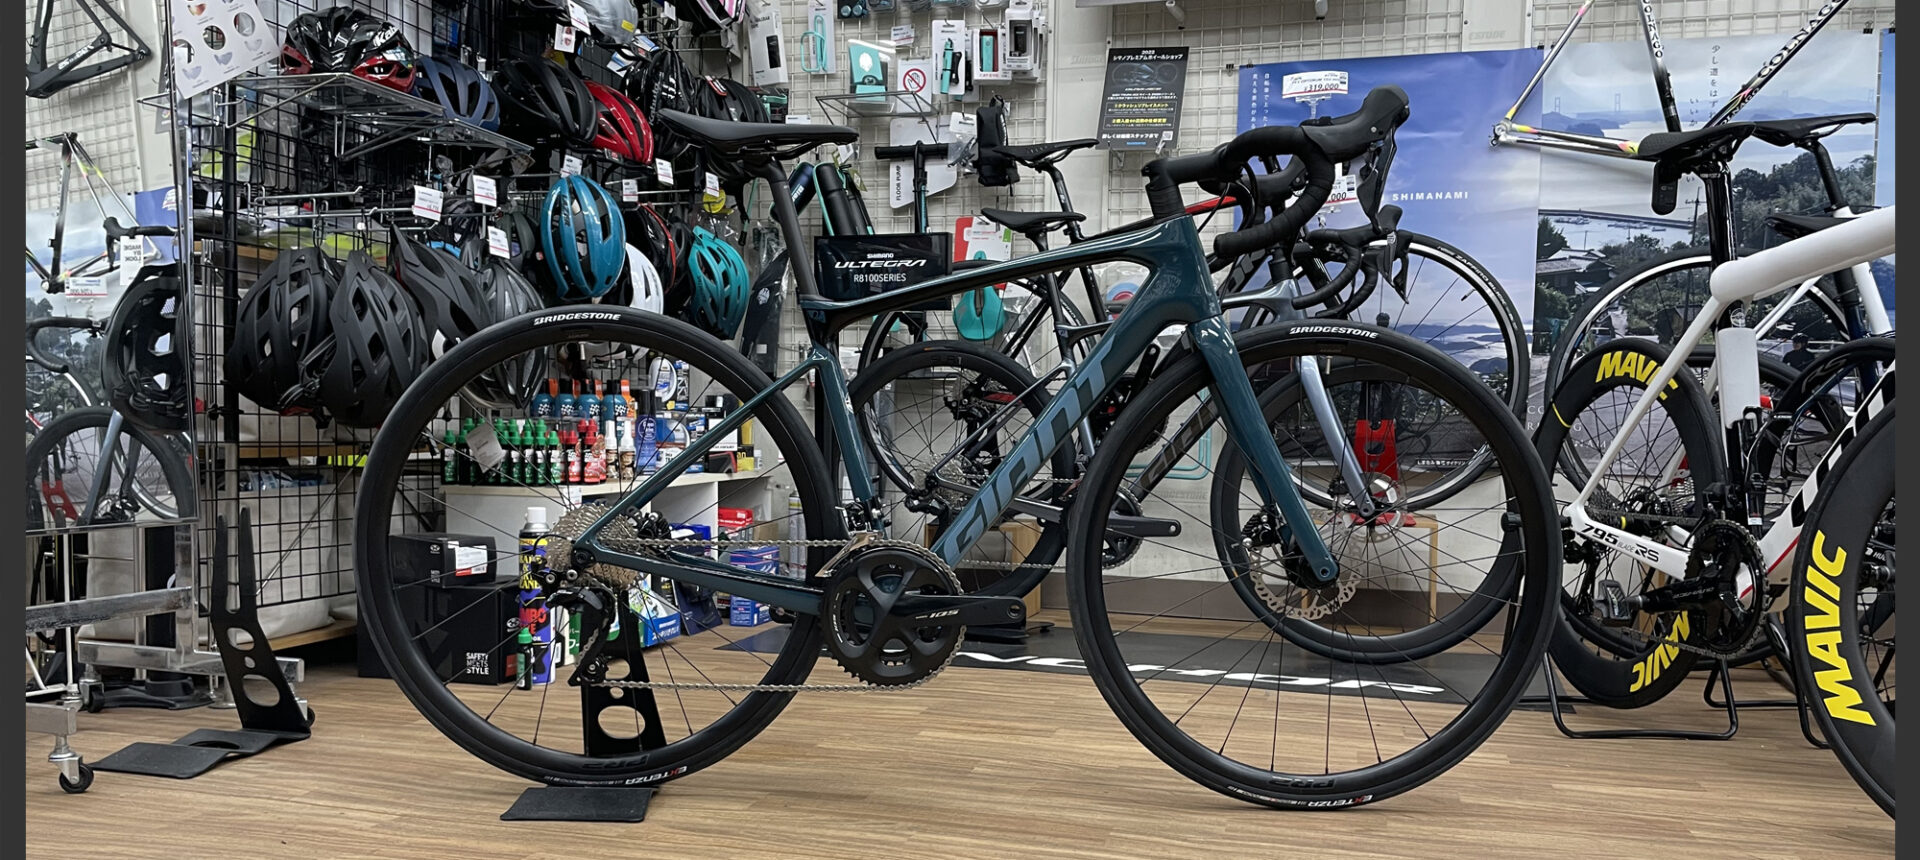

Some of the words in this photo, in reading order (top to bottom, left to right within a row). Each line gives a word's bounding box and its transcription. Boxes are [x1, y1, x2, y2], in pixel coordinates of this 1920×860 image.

[1720, 87, 1760, 125] OLNAGO
[1392, 191, 1469, 201] SHIMANAMI
[834, 259, 927, 269] ULTEGRA
[853, 273, 907, 283] R8100SERIES
[533, 312, 622, 326] BRIDGESTONE
[1289, 326, 1380, 339] BRIDGESTONE
[942, 331, 1118, 568] GIANT
[1582, 523, 1620, 545] 795
[1634, 543, 1659, 563] RS
[928, 608, 961, 619] 105
[1804, 529, 1877, 726] MAVIC
[955, 651, 1446, 695] NCHOR
[624, 765, 688, 785] EXTENZA
[1307, 794, 1374, 807] EXTENZA
